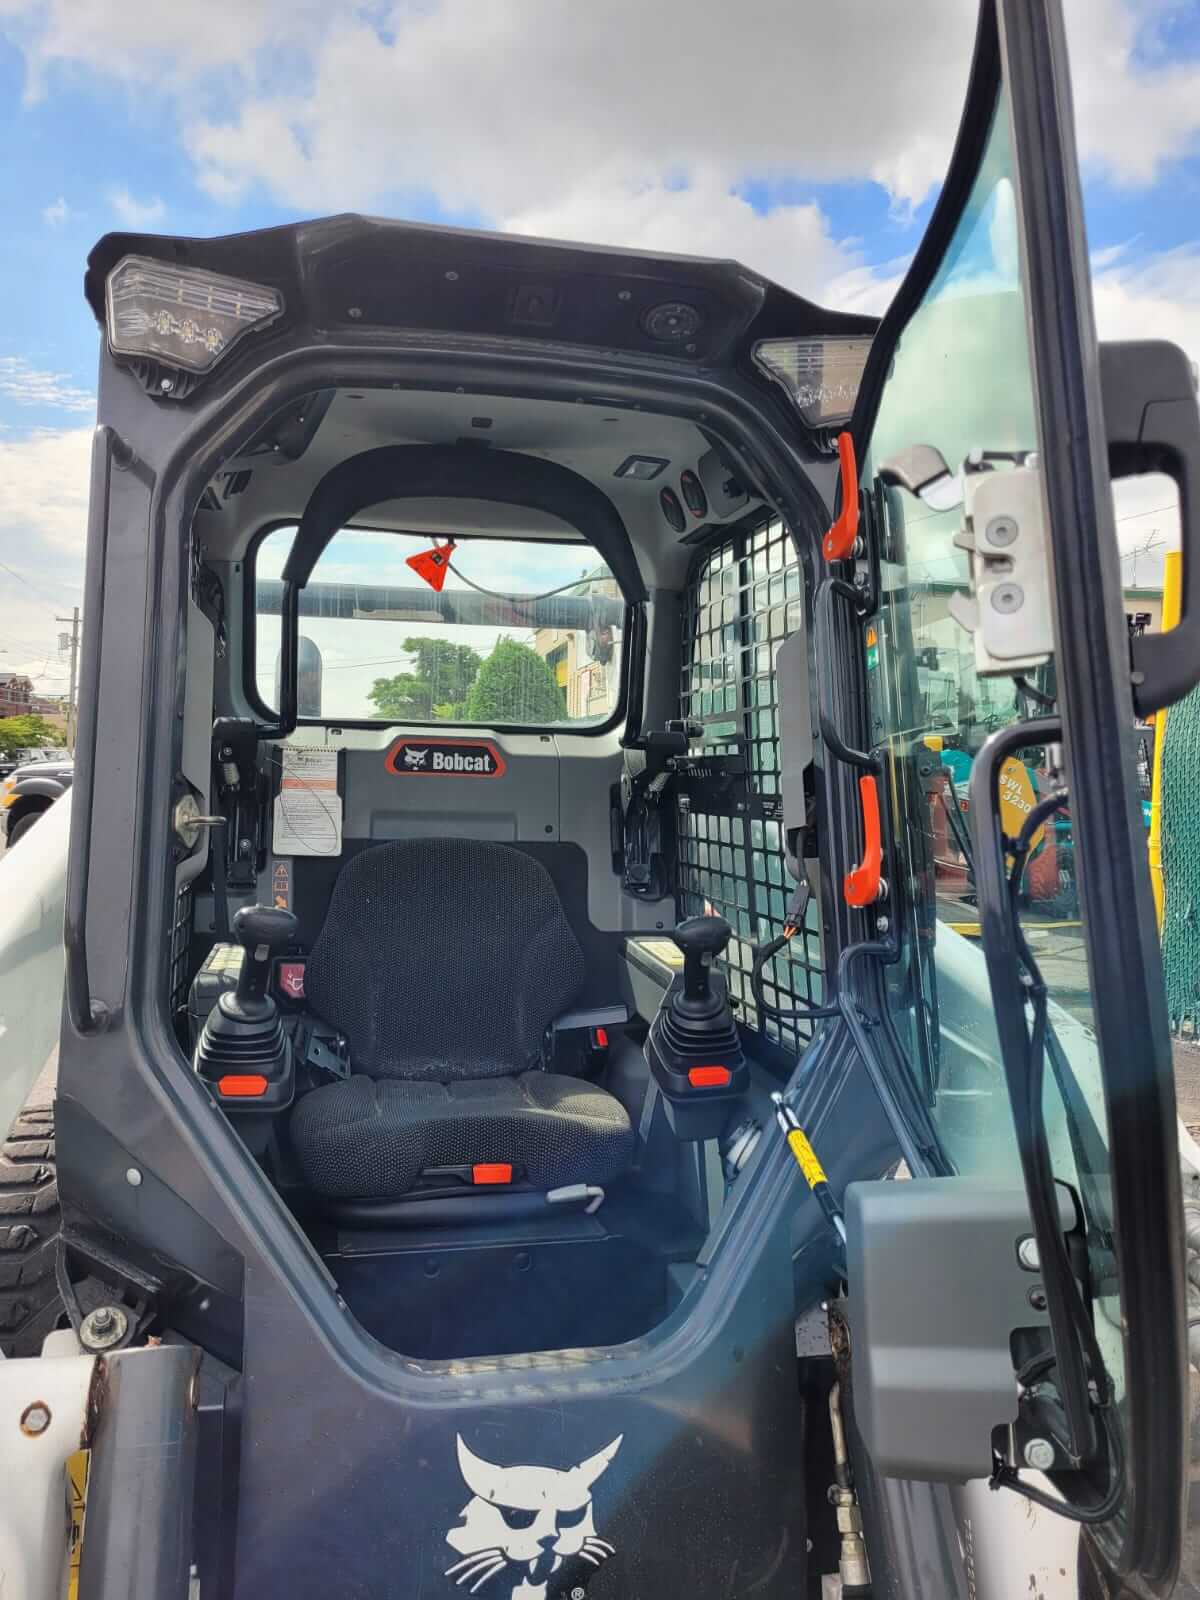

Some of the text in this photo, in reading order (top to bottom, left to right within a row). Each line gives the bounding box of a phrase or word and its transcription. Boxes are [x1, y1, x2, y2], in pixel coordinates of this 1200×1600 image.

[432, 751, 490, 772] Bobcat
[999, 774, 1023, 796] SWL
[1003, 791, 1032, 813] 3230
